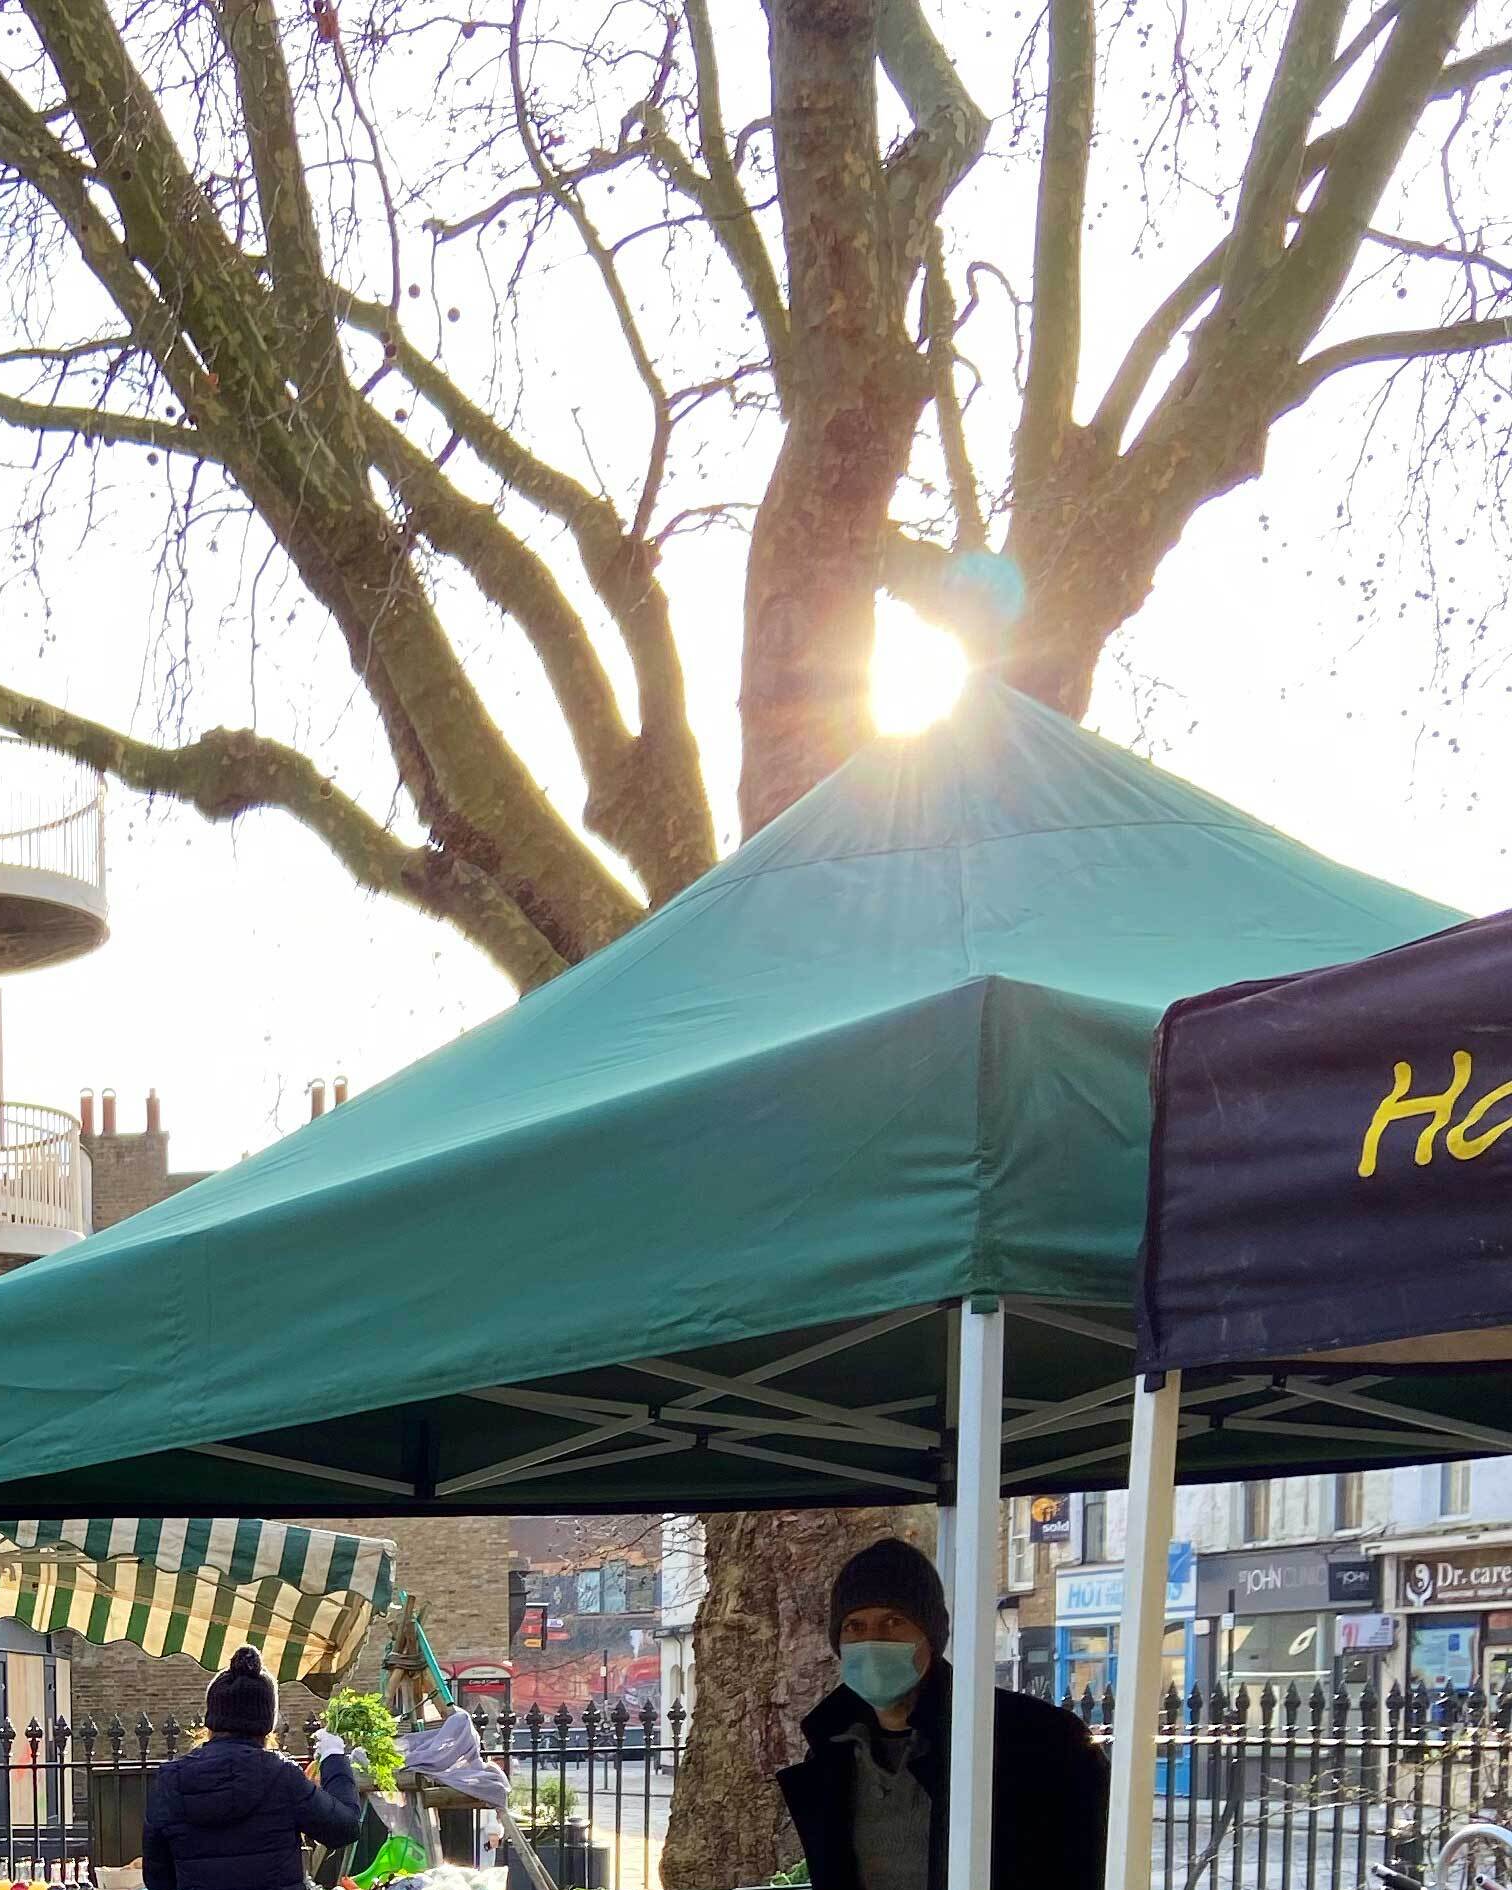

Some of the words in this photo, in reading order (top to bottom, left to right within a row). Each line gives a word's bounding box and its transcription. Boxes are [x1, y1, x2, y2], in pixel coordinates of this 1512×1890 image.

[1042, 1520, 1071, 1533] sold
[1247, 1564, 1282, 1595] JOHN
[1068, 1583, 1103, 1609] HOT
